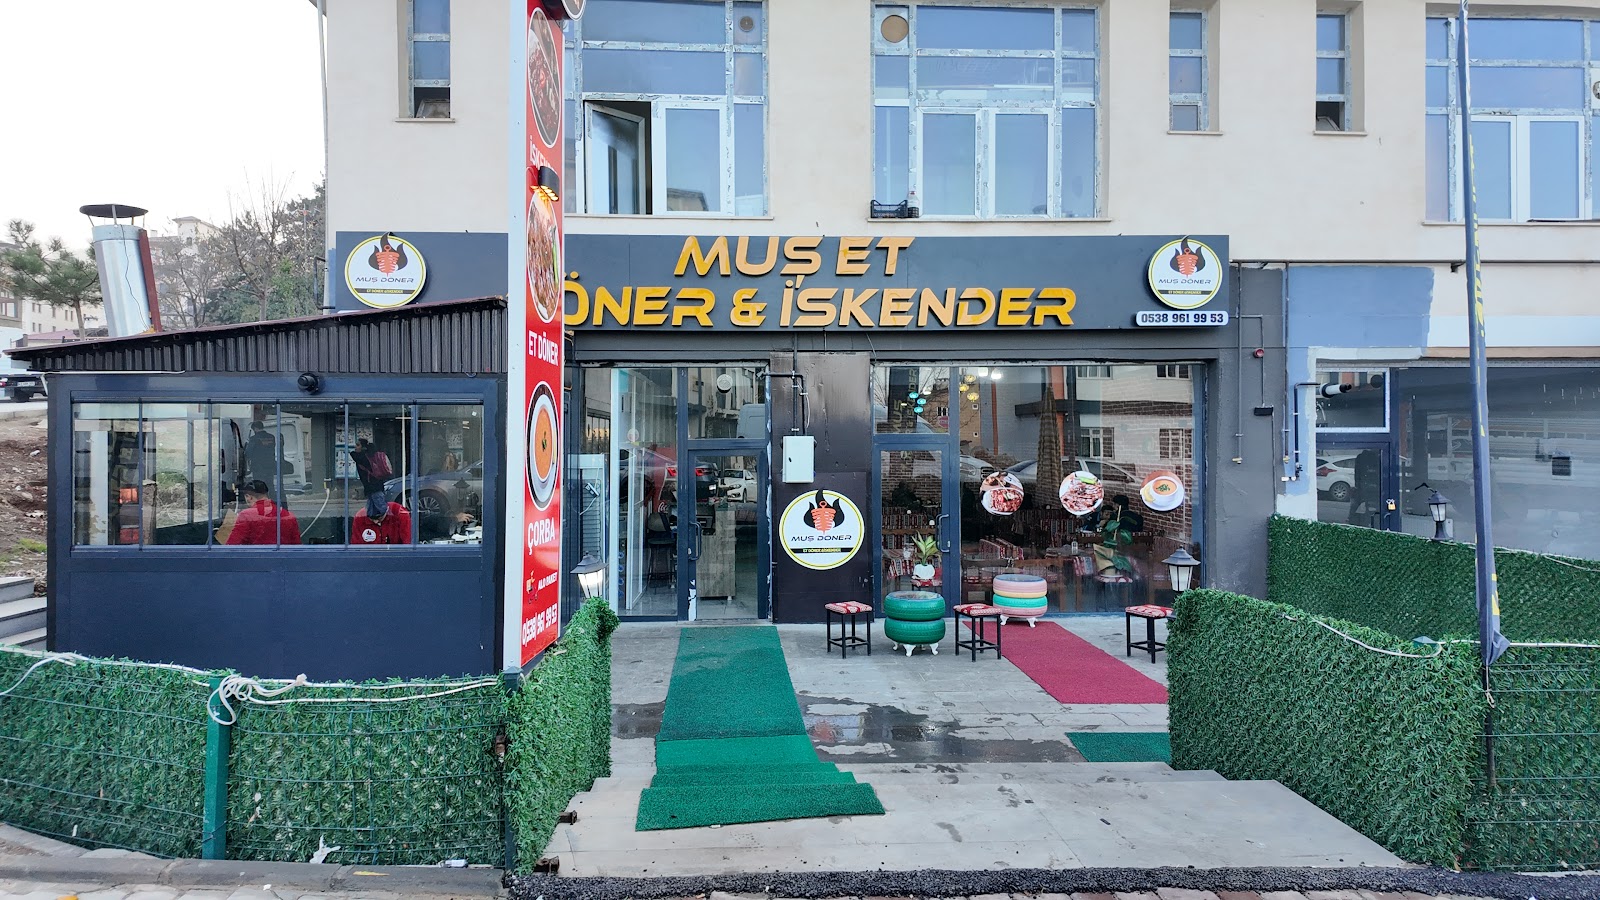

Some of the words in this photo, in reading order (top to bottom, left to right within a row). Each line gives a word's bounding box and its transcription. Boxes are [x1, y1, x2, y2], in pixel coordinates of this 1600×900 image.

[835, 236, 915, 275] ET
[564, 271, 716, 327] ÖNER
[730, 288, 768, 327] &
[779, 279, 1077, 327] İSKENDER
[1141, 313, 1169, 324] 0538
[1172, 313, 1190, 324] 961
[1193, 313, 1207, 324] 99
[1210, 313, 1224, 323] 53
[528, 330, 538, 357] ET
[538, 331, 558, 367] DÖNER
[527, 517, 556, 556] ÇORBA
